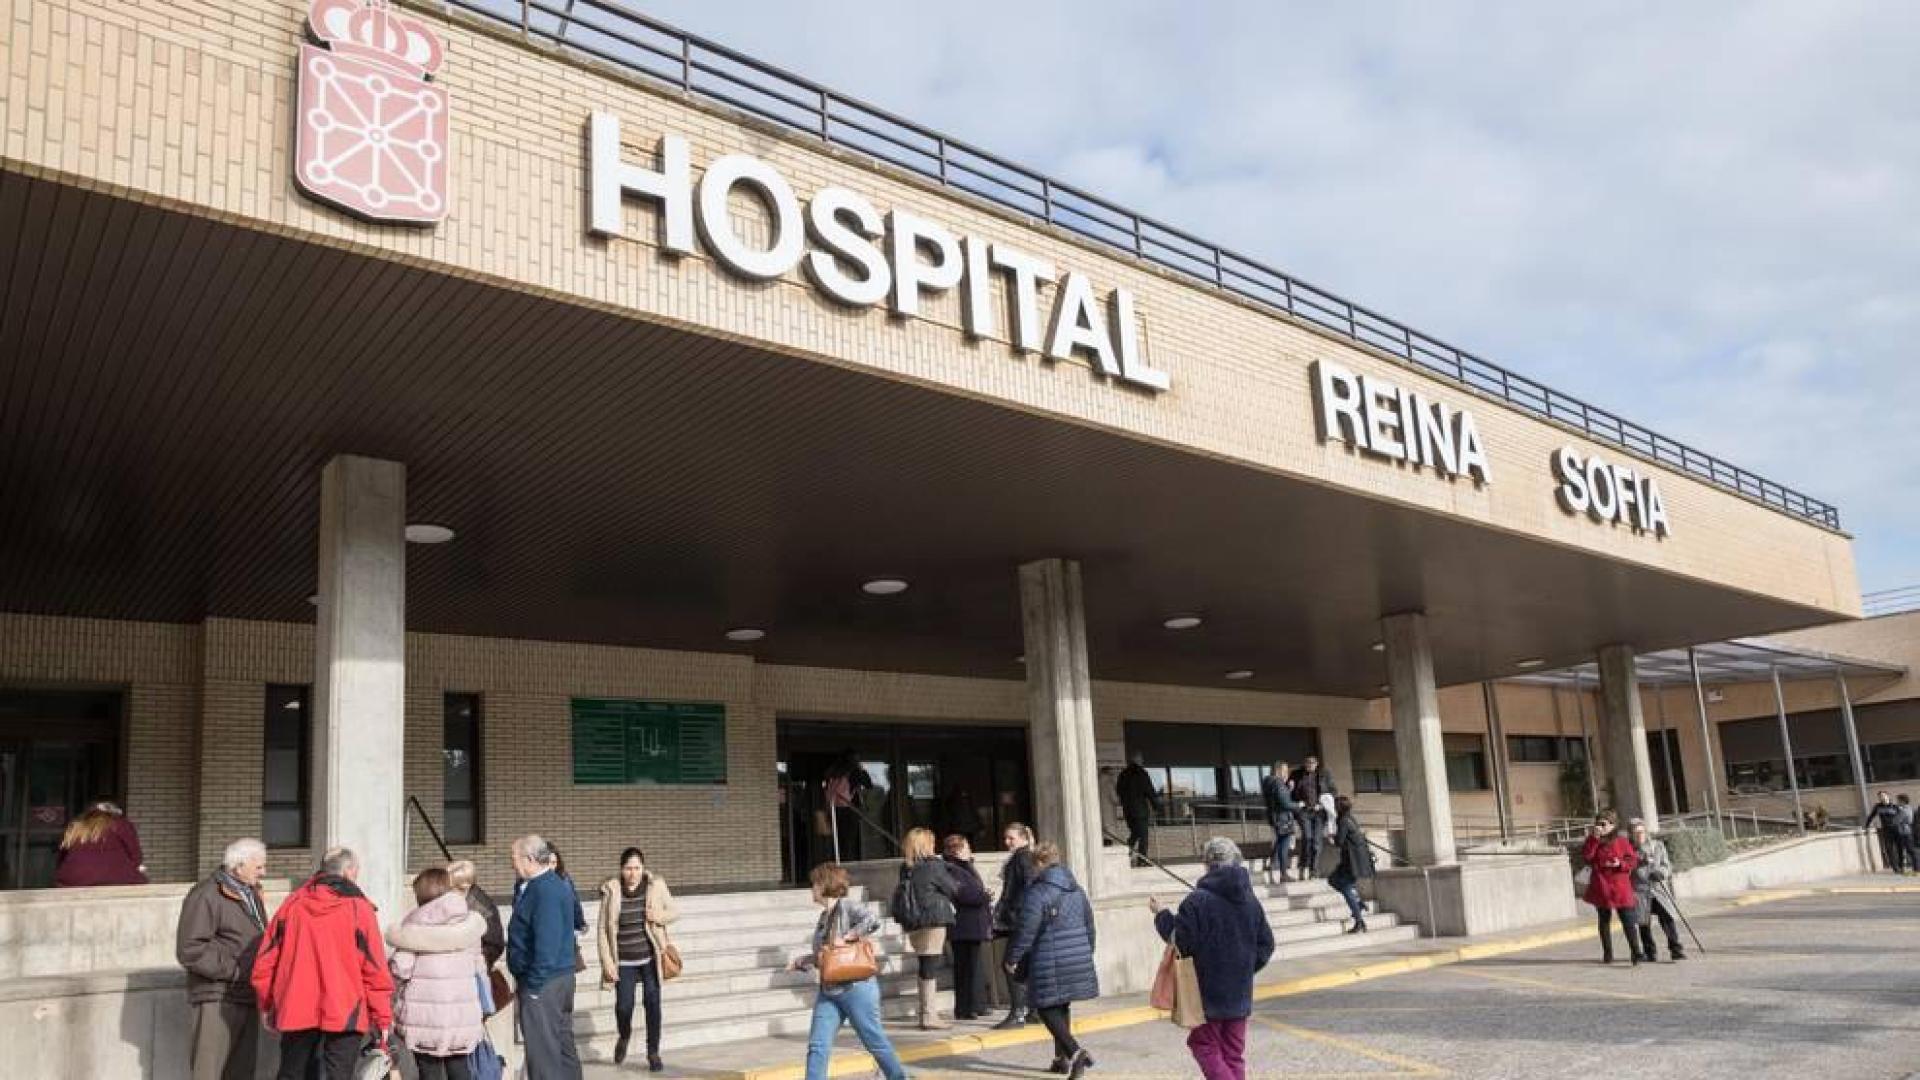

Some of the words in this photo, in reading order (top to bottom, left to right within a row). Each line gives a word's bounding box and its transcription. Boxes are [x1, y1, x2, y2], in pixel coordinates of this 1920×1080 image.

[587, 109, 1171, 392] HOSPITAL
[1310, 358, 1491, 486] REINA
[1552, 444, 1672, 538] SOFIA
